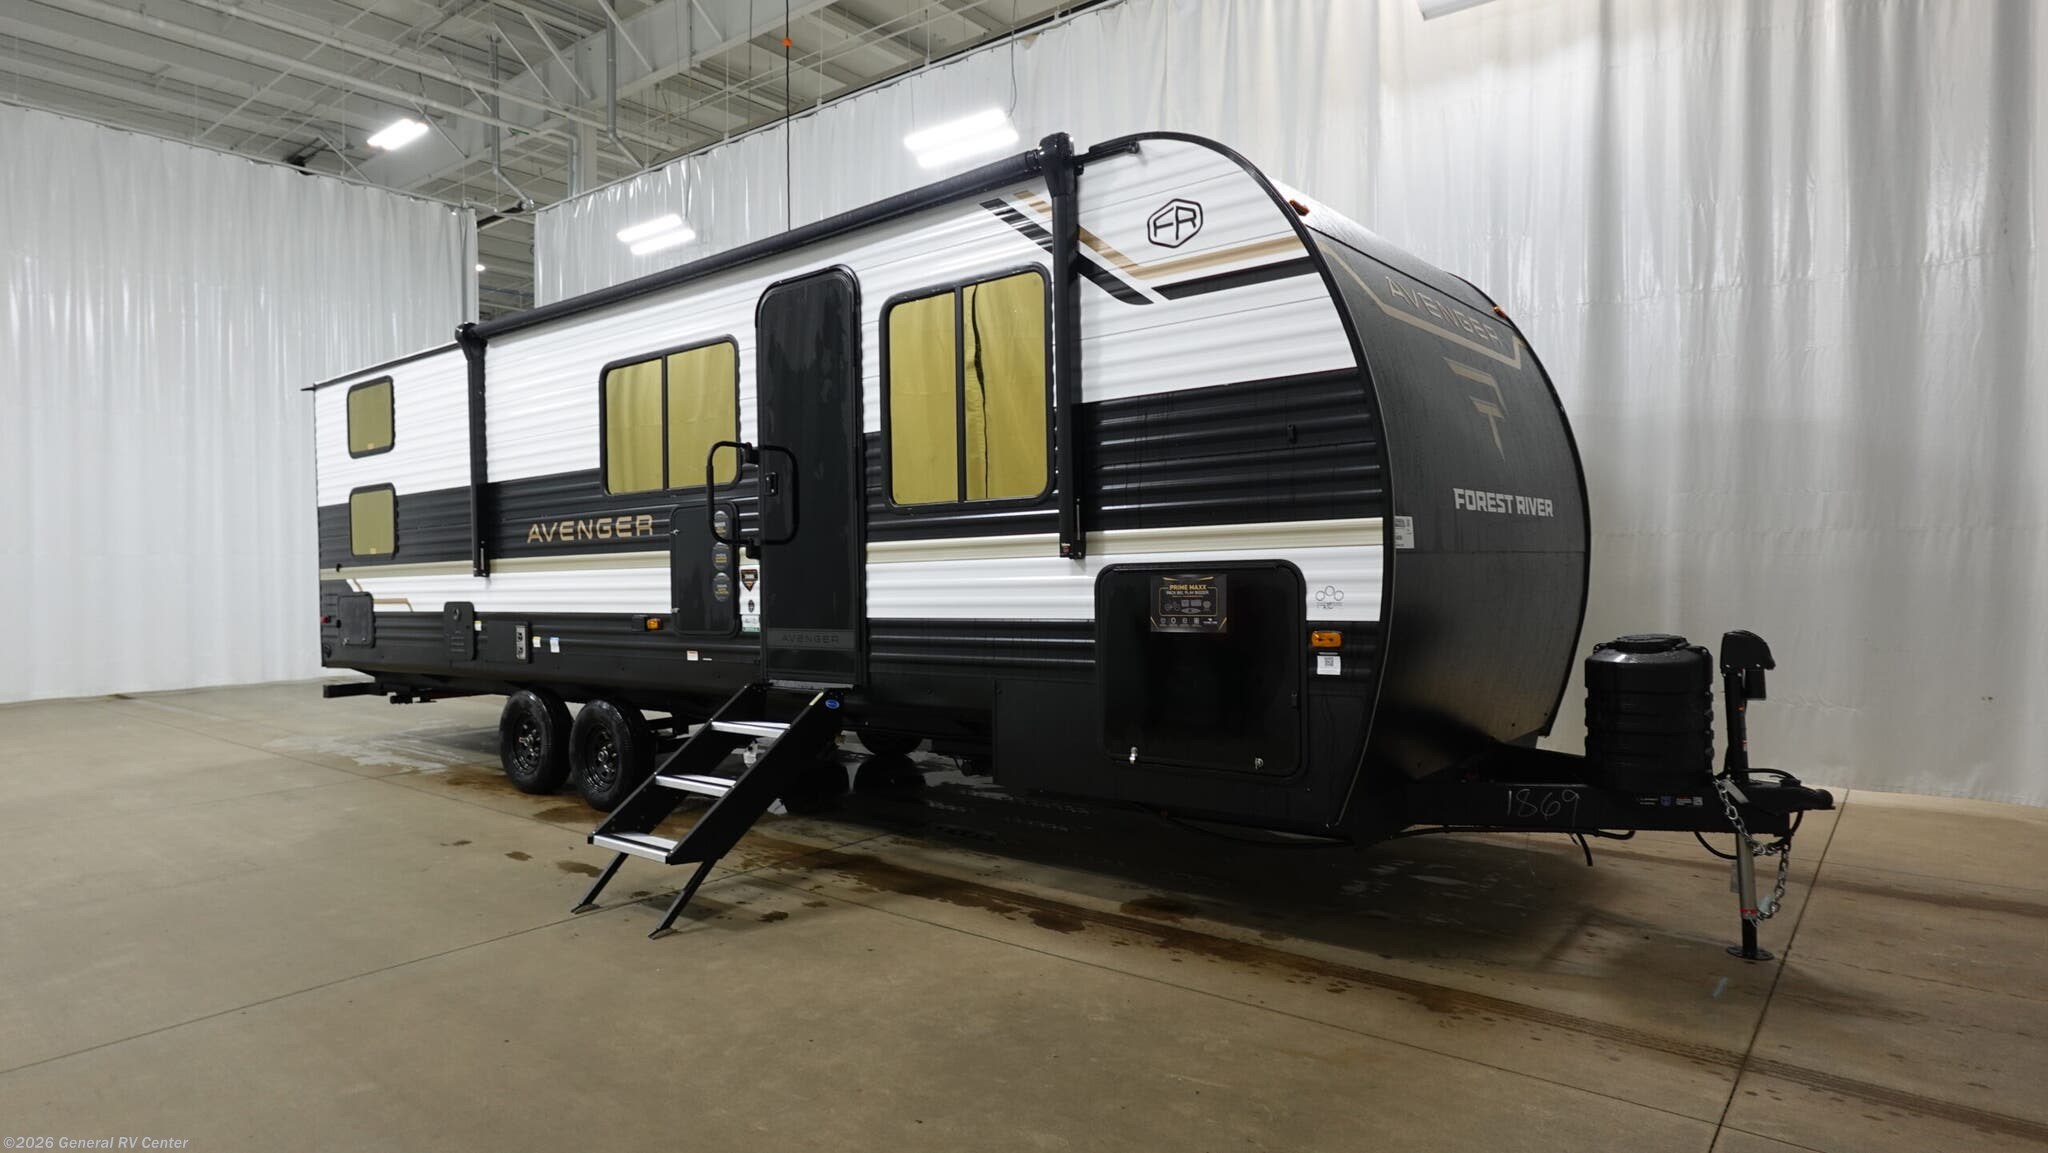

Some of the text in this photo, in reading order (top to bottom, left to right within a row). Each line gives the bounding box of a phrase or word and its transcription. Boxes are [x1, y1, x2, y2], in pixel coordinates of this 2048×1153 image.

[1385, 276, 1503, 346] AVENGER
[1453, 487, 1554, 518] FOREST RIVER
[526, 514, 654, 544] AVENGER
[1507, 788, 1581, 828] 1869
